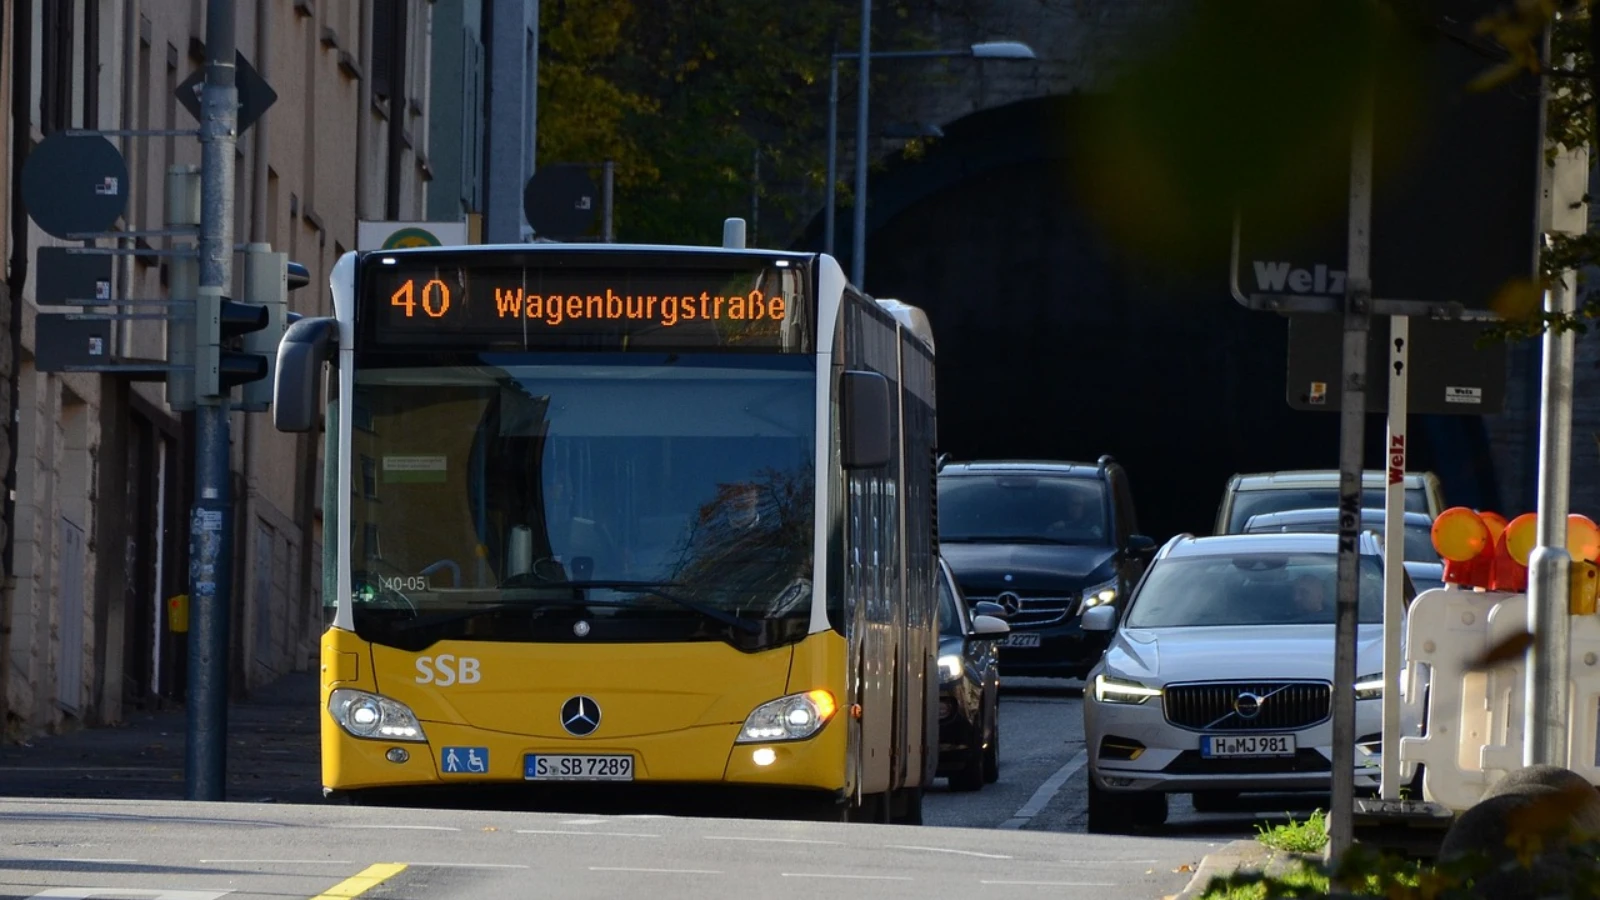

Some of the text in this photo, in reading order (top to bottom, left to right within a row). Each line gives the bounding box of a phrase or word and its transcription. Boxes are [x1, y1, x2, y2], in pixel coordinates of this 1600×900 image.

[1252, 260, 1347, 294] Welz
[391, 279, 785, 326] 40 Wagenburgstraße
[1388, 434, 1405, 486] Welz
[1341, 491, 1359, 553] Welz
[384, 576, 426, 591] 40-05
[1011, 634, 1038, 646] 2277
[415, 654, 481, 687] SSB
[1215, 737, 1288, 753] H MJ 981
[537, 758, 630, 775] S SB 7289
